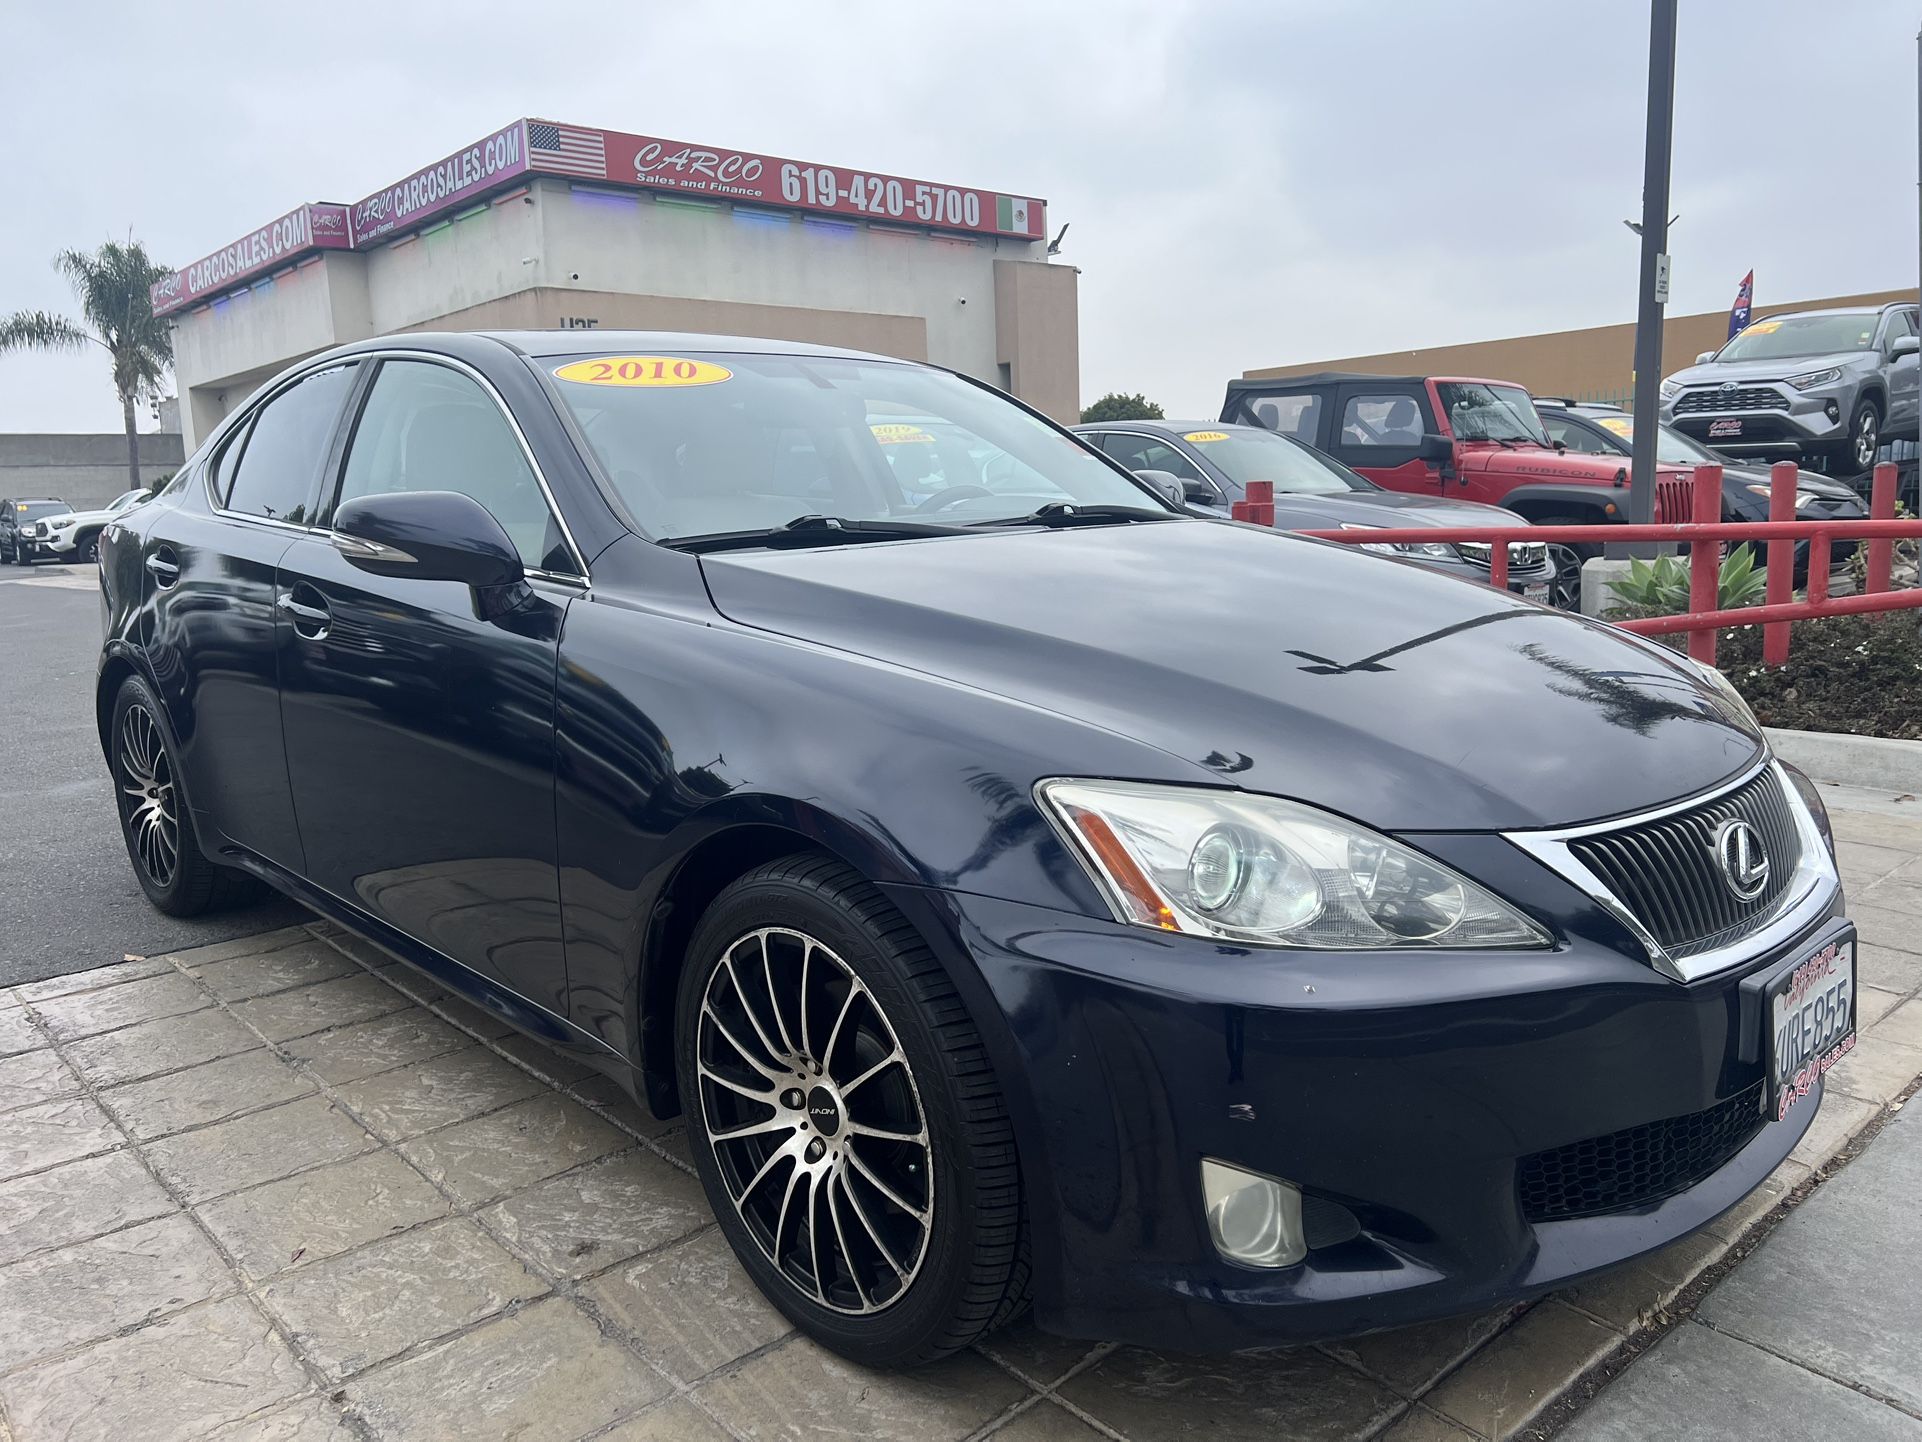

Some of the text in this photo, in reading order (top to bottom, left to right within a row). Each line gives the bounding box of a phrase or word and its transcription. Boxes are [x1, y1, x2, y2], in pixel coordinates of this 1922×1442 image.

[395, 127, 519, 218] CARCOSALES.COM
[633, 142, 763, 183] CARCO
[636, 172, 763, 197] Sales and Finance
[780, 163, 980, 227] 619-420-5700
[312, 213, 342, 228] CARCO
[355, 190, 392, 230] CARCO
[357, 220, 394, 243] Sales and Finance
[188, 210, 305, 294] CARCOSALES.COM
[590, 361, 697, 381] 2010
[1515, 465, 1597, 477] RUBICON
